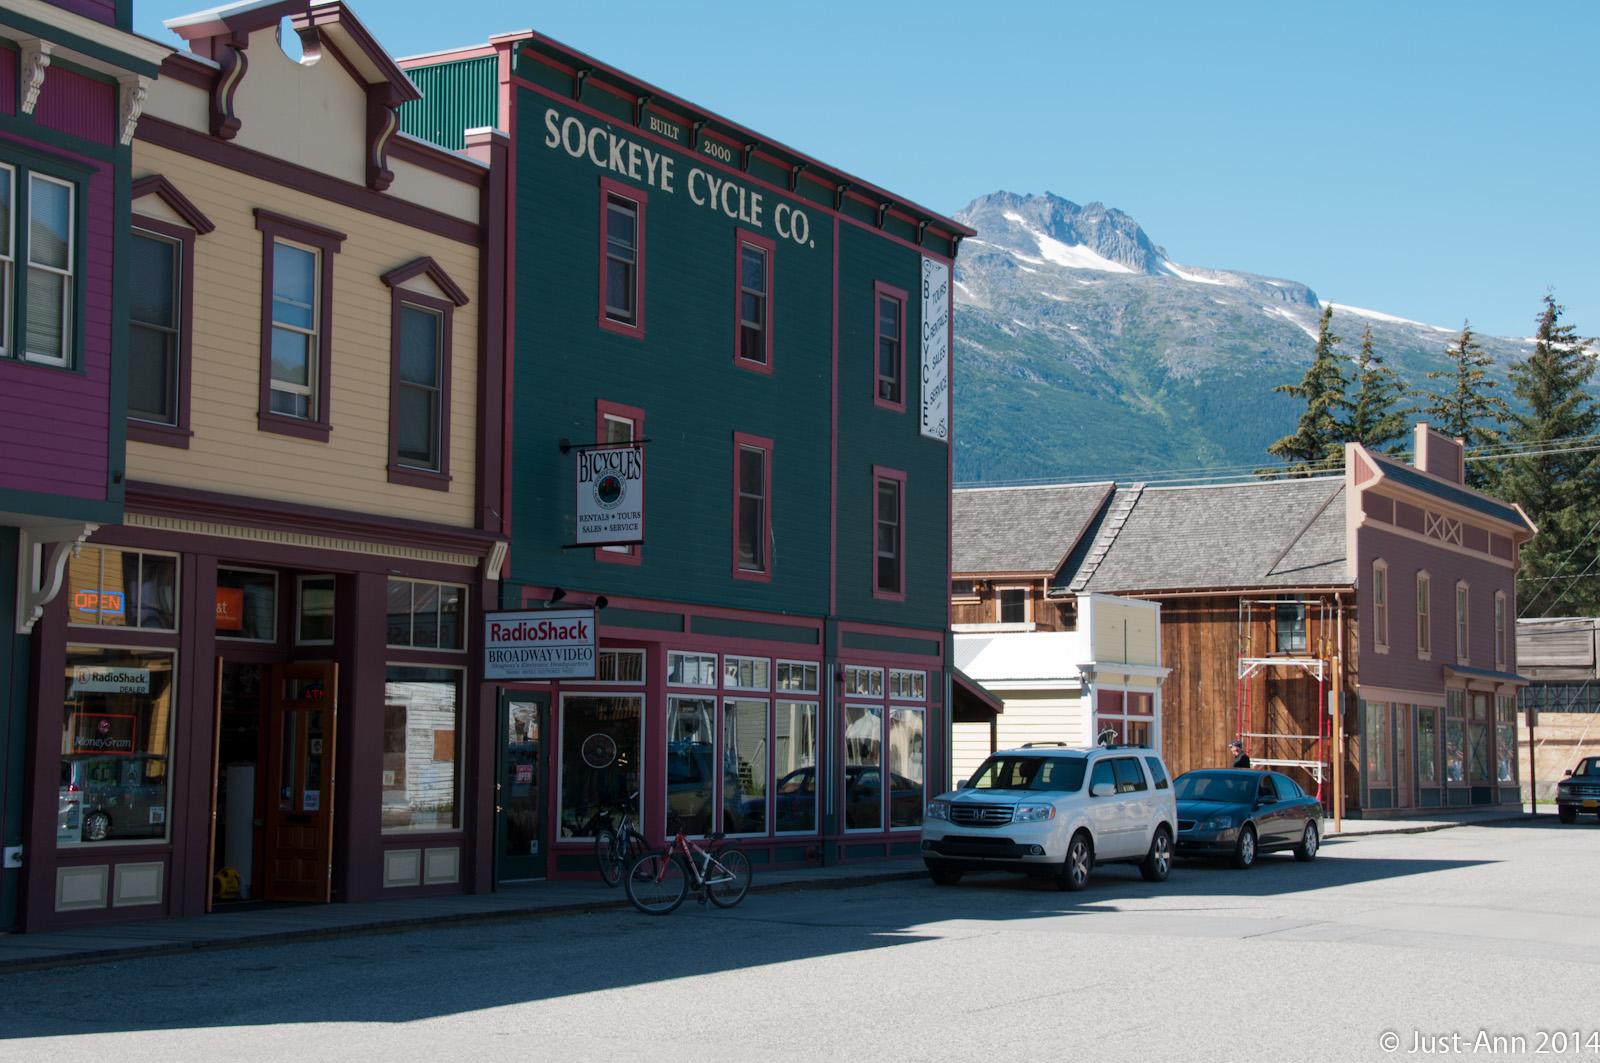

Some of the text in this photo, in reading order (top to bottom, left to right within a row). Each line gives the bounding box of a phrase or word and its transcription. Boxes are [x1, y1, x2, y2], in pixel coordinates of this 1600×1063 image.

[649, 116, 731, 163] BUILT 2000
[544, 108, 815, 248] SOCKEYE CYCLE CO.
[932, 281, 948, 305] TOURS
[922, 280, 930, 426] BICYCLE
[931, 345, 946, 370] SALES
[579, 451, 641, 482] BICYCLES
[579, 511, 641, 522] RENTALS TOURS
[582, 523, 639, 533] SALES SERVICE
[74, 592, 121, 611] OPEN
[491, 620, 587, 641] RadioShack
[488, 647, 593, 663] BROADWAY VIDEO
[92, 671, 145, 684] RadioShack
[119, 686, 146, 694] DEALER
[74, 736, 132, 748] MoneyGram
